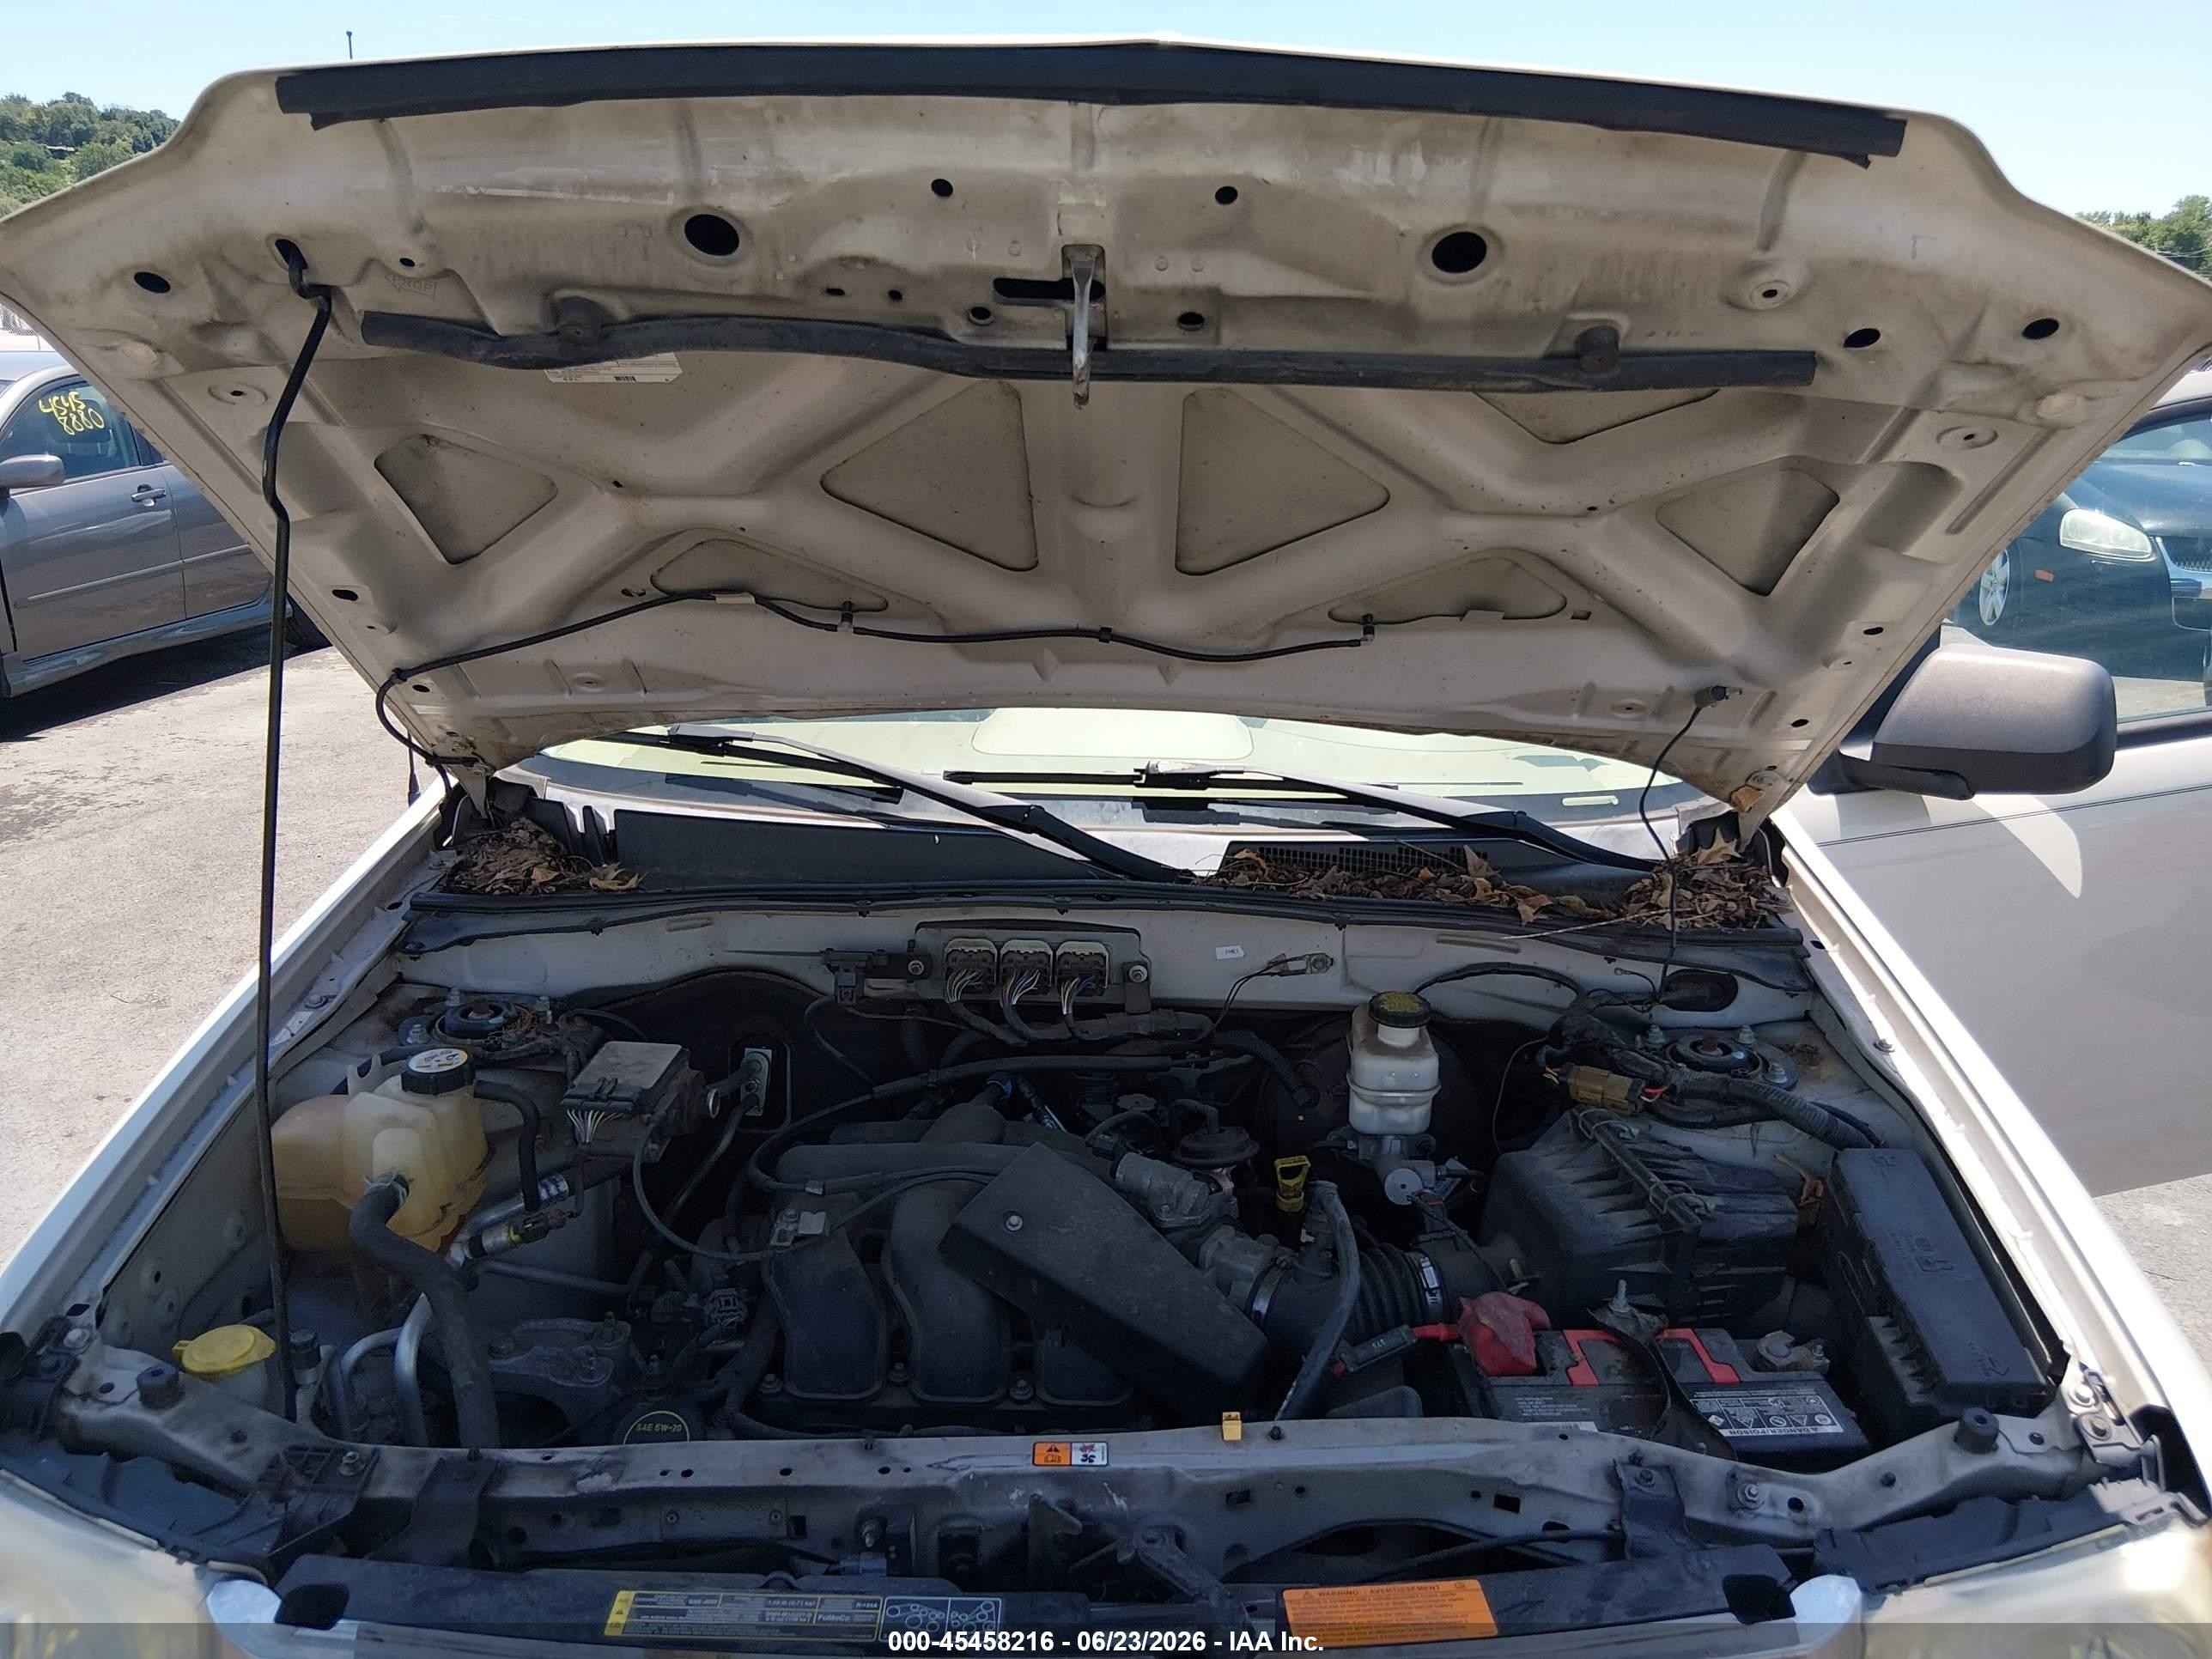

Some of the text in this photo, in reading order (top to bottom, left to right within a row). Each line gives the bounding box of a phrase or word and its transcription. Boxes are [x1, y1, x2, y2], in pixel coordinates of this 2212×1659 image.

[39, 392, 86, 416] 4545
[58, 408, 105, 435] 8880
[635, 1423, 653, 1431] SAE
[1318, 1589, 1359, 1597] WARNING
